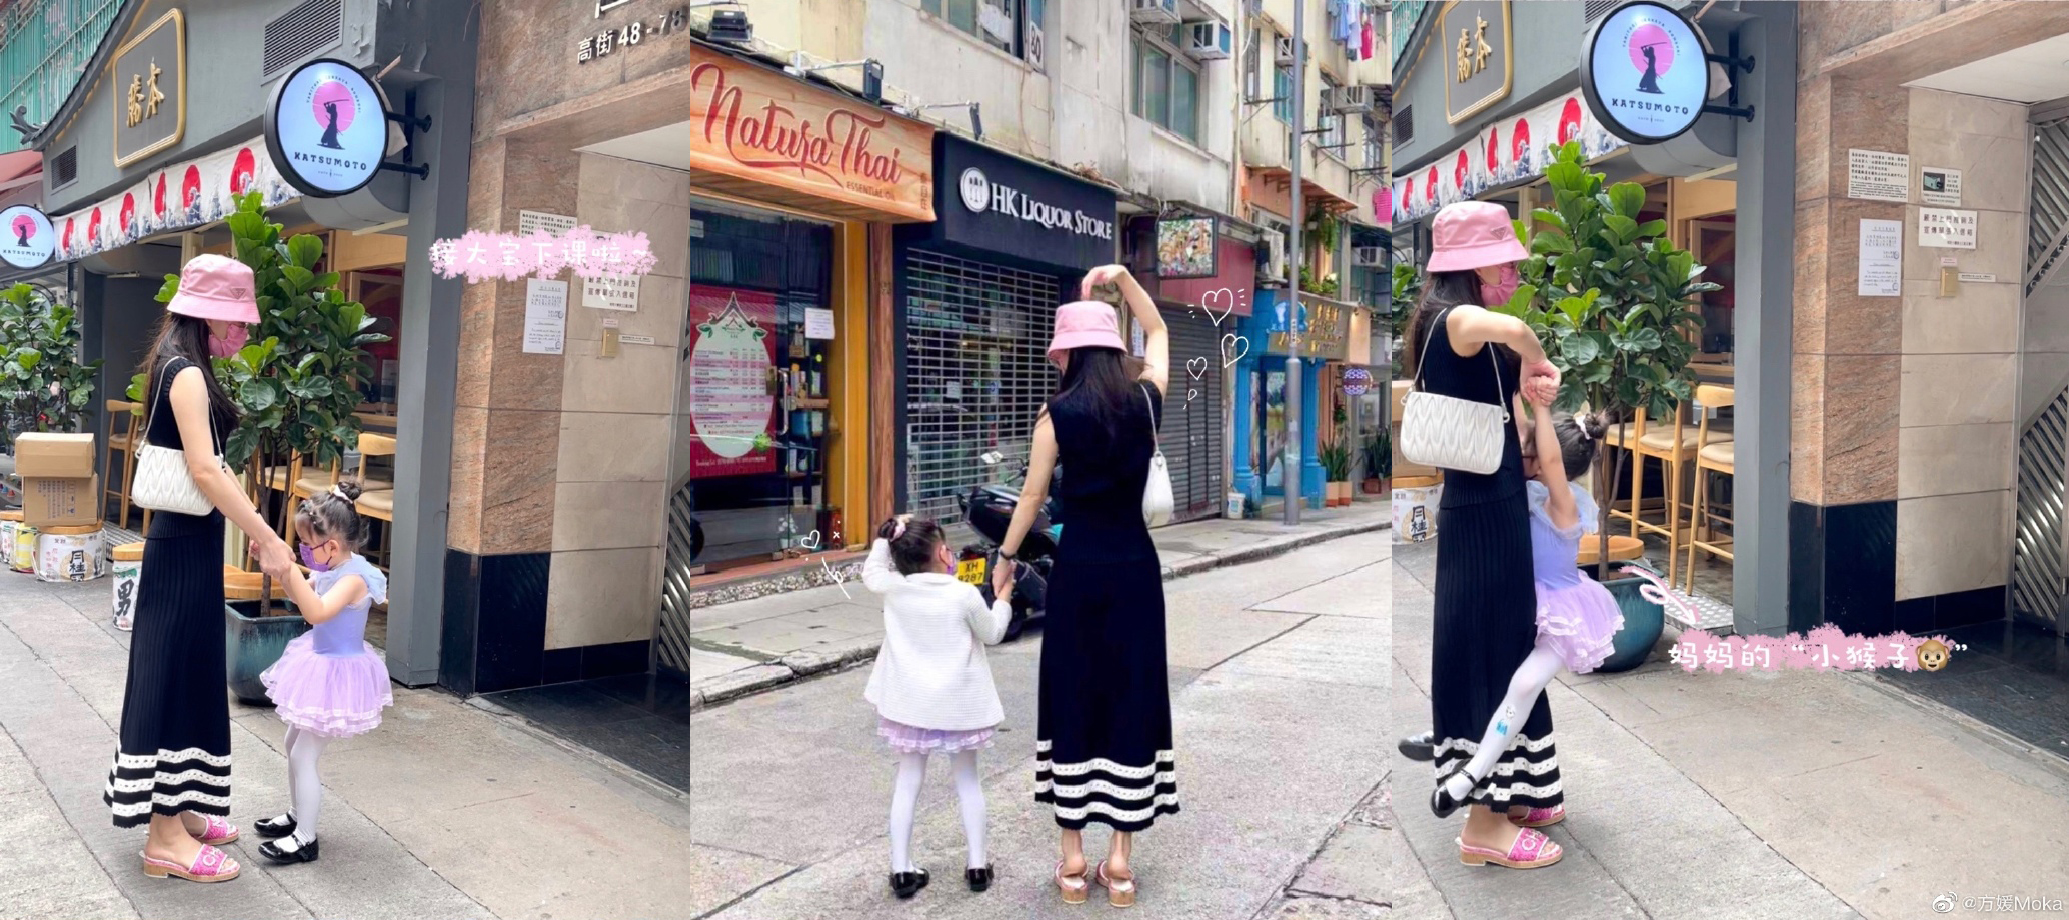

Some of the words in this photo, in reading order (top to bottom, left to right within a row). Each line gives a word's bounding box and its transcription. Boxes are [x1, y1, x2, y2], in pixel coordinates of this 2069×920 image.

[577, 30, 613, 64] 高街
[1457, 9, 1492, 84] 勝本
[126, 57, 165, 128] 勝本
[1611, 98, 1689, 115] KATSUMOTO
[294, 151, 367, 171] KATSUMOTO
[826, 108, 902, 184] Thai
[991, 183, 1019, 217] HK
[1021, 193, 1073, 229] LIQUOR
[1075, 210, 1113, 240] STORE
